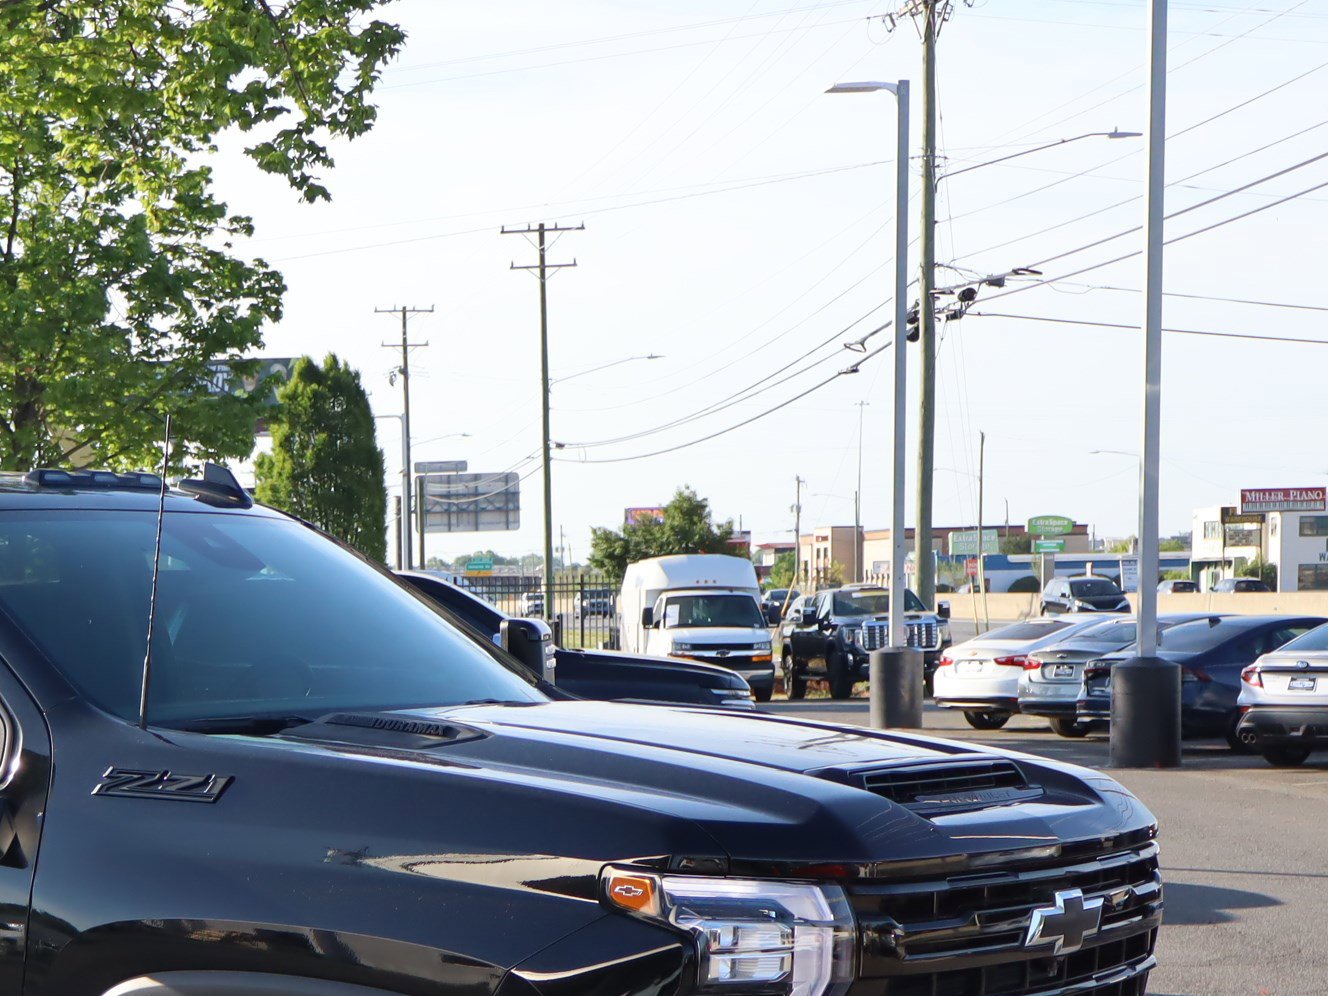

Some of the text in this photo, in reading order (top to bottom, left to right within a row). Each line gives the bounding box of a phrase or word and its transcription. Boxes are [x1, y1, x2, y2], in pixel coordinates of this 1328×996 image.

[1245, 488, 1323, 502] MILLER PIANO
[91, 765, 236, 803] Z71
